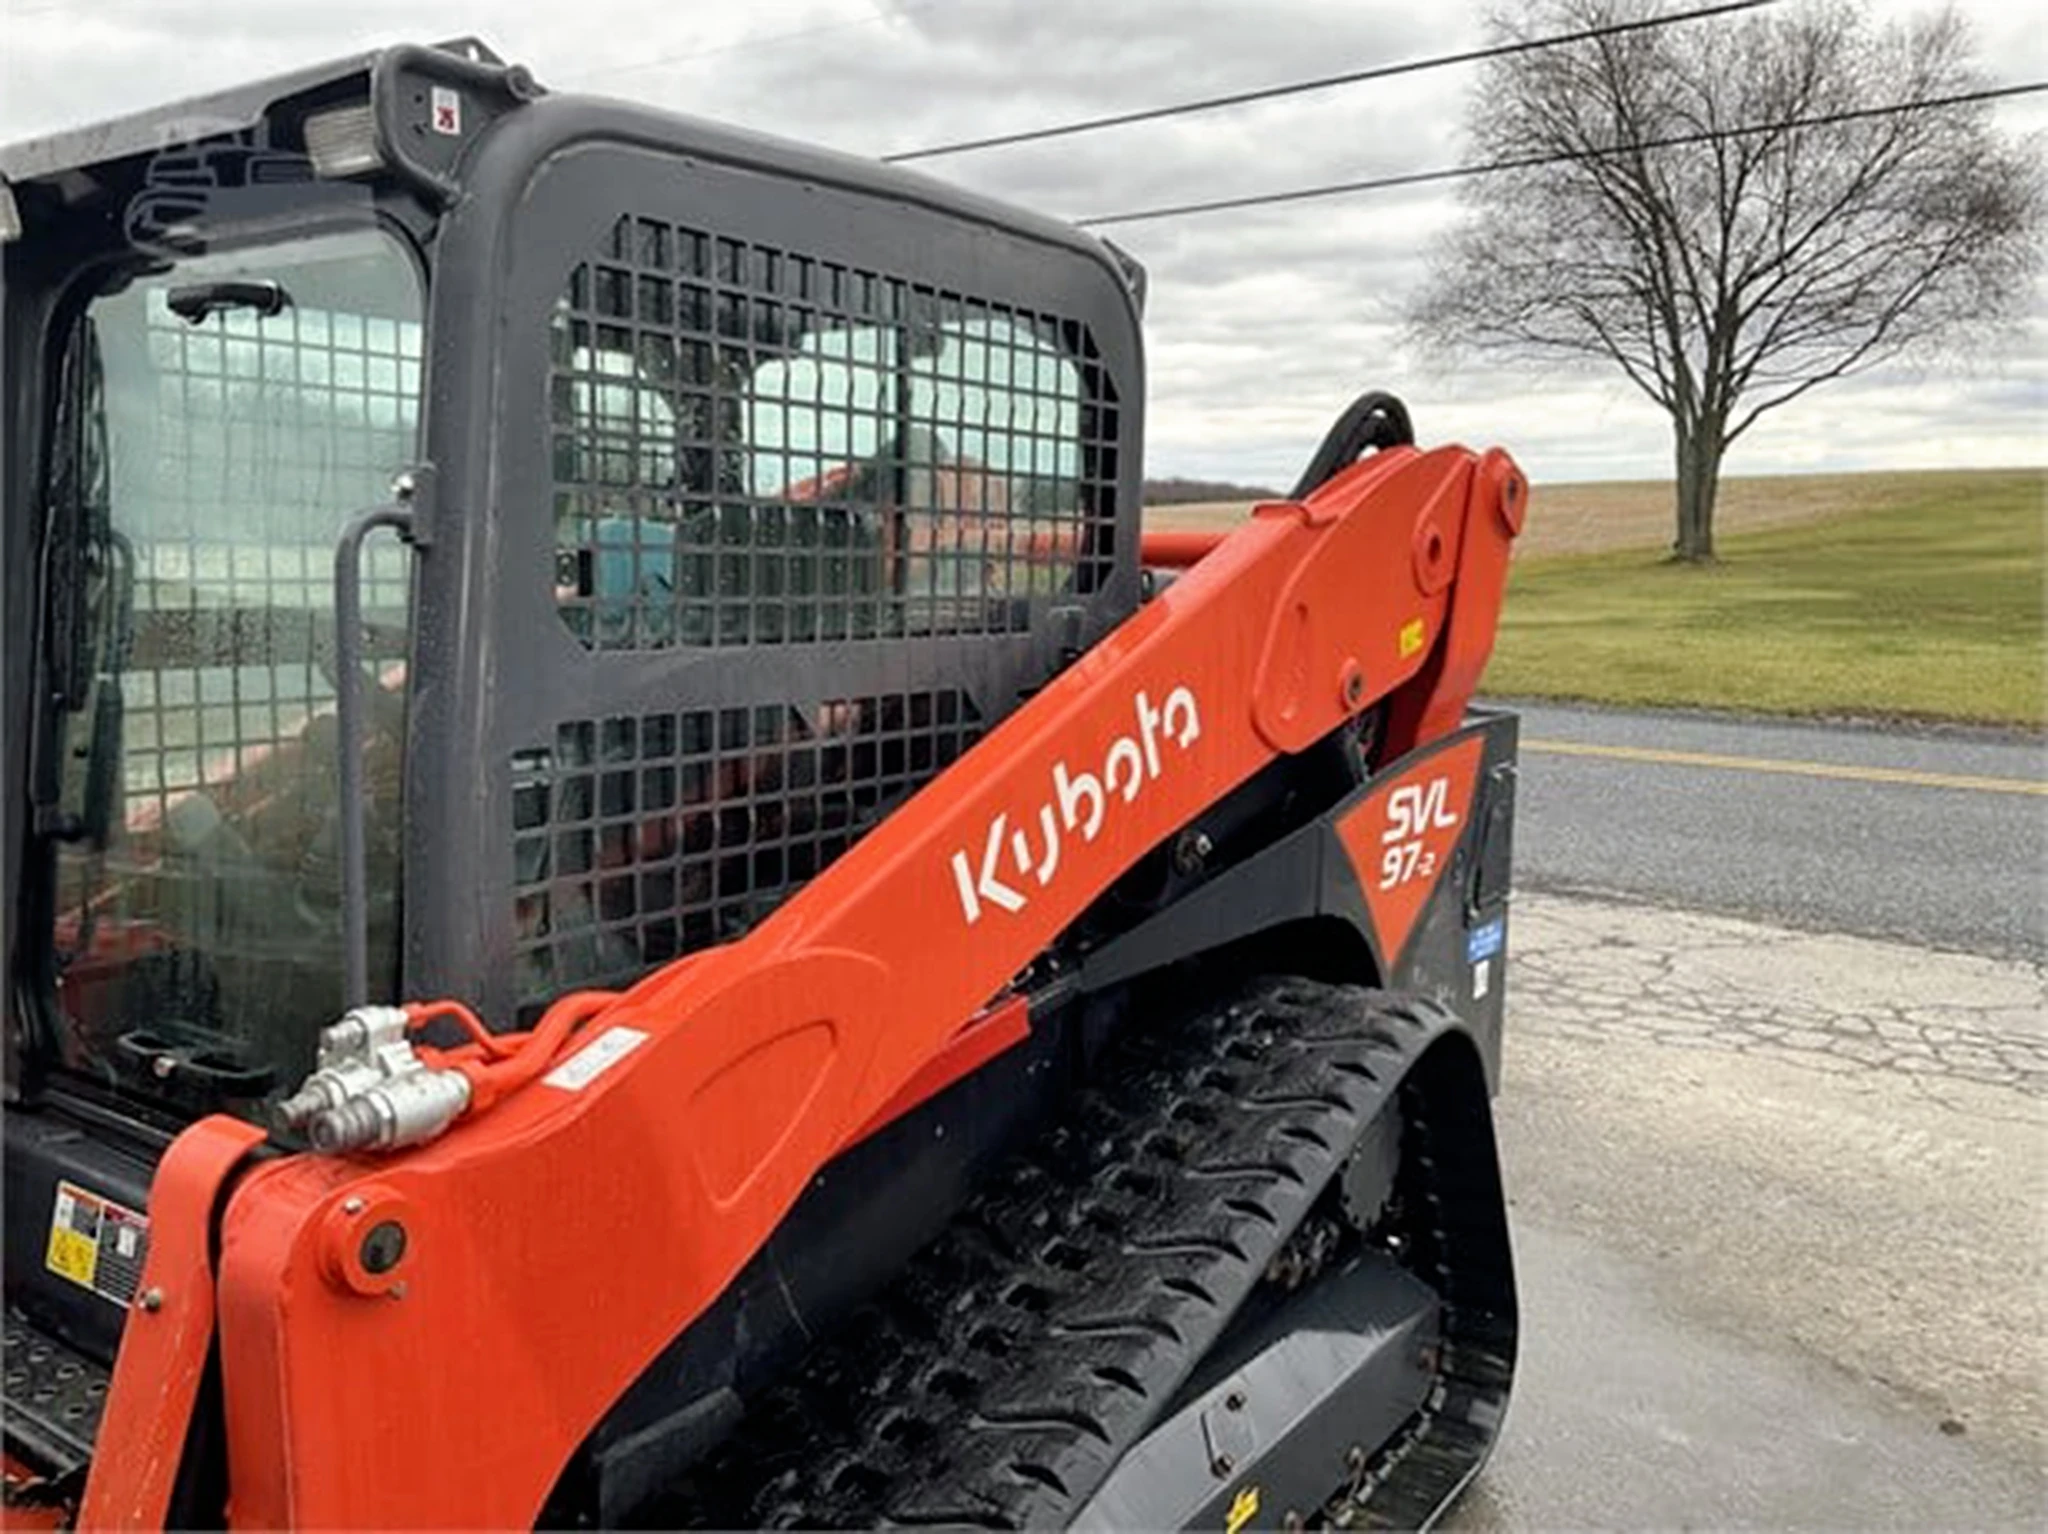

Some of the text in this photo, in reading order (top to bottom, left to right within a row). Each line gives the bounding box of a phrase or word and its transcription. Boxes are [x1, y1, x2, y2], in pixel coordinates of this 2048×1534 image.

[952, 687, 1199, 925] Kubota
[1381, 777, 1458, 844] SVL
[1380, 841, 1435, 889] 97-2
